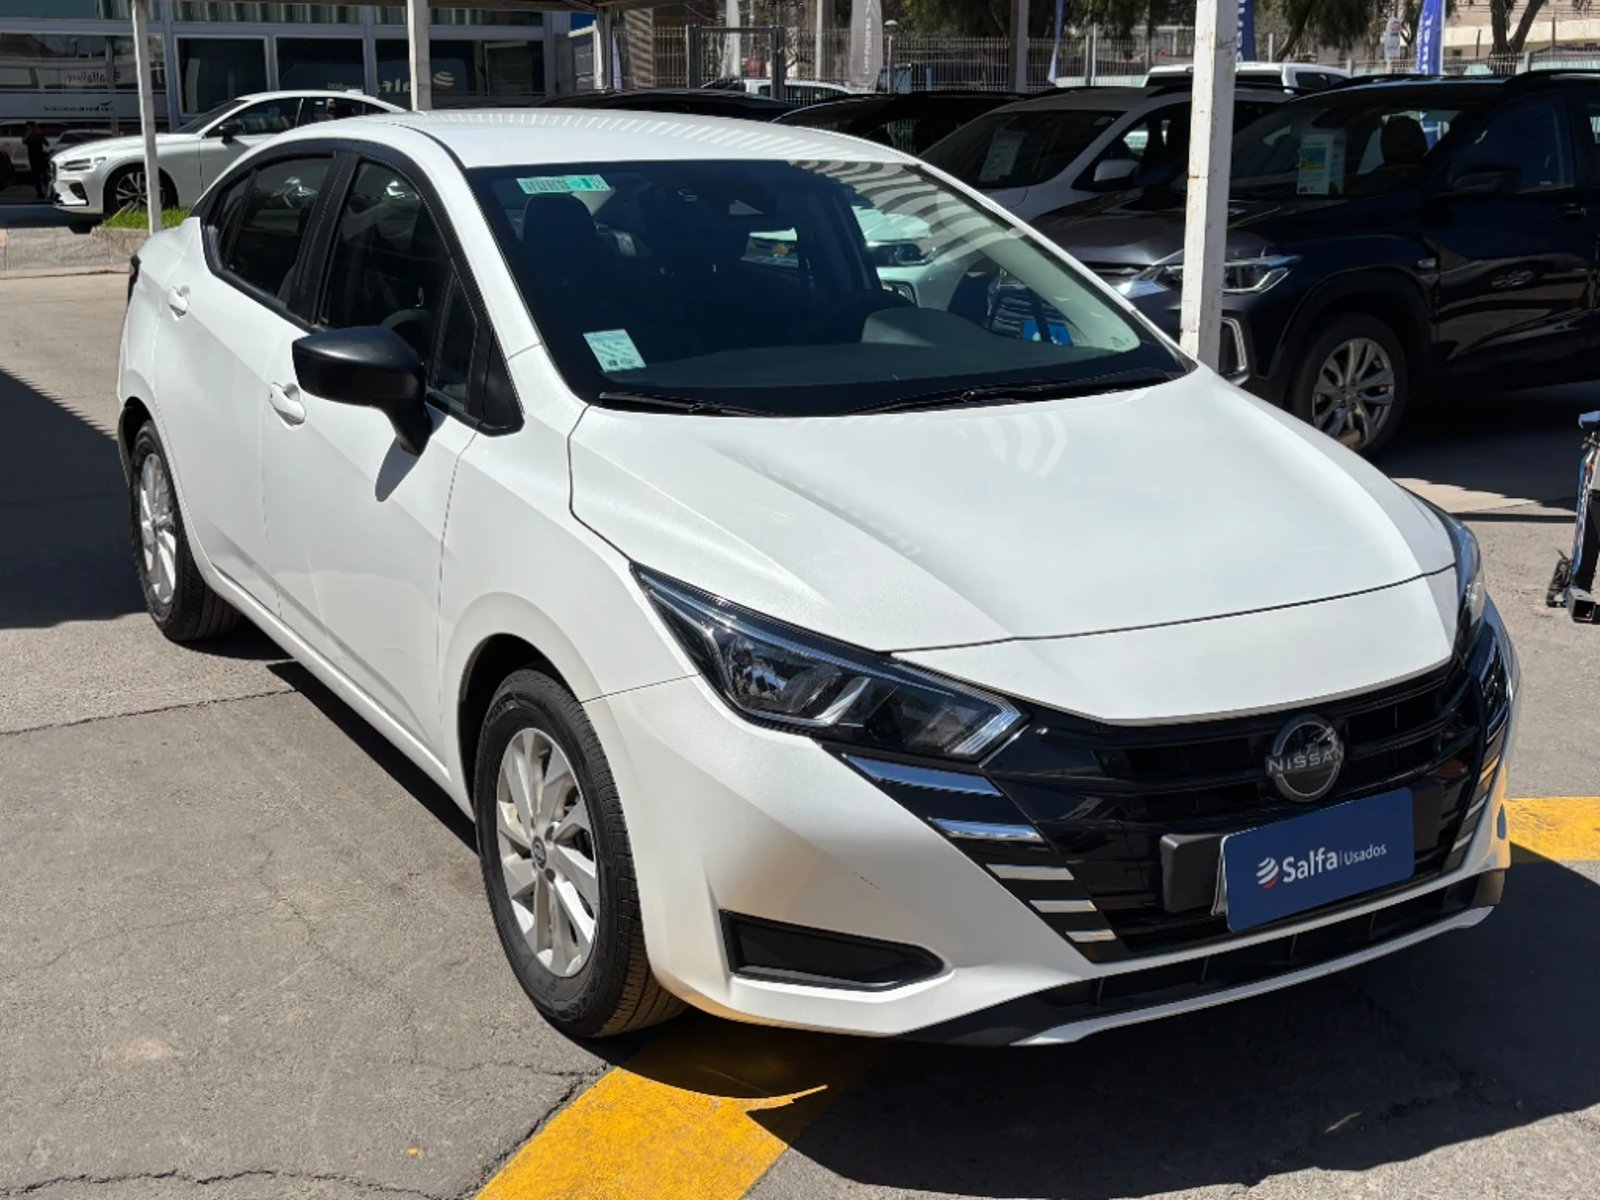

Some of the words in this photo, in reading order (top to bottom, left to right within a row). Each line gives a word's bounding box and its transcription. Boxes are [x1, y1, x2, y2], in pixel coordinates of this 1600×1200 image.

[1267, 749, 1344, 772] NISSAN
[1282, 847, 1338, 882] Salfa
[1343, 844, 1387, 865] Usados
